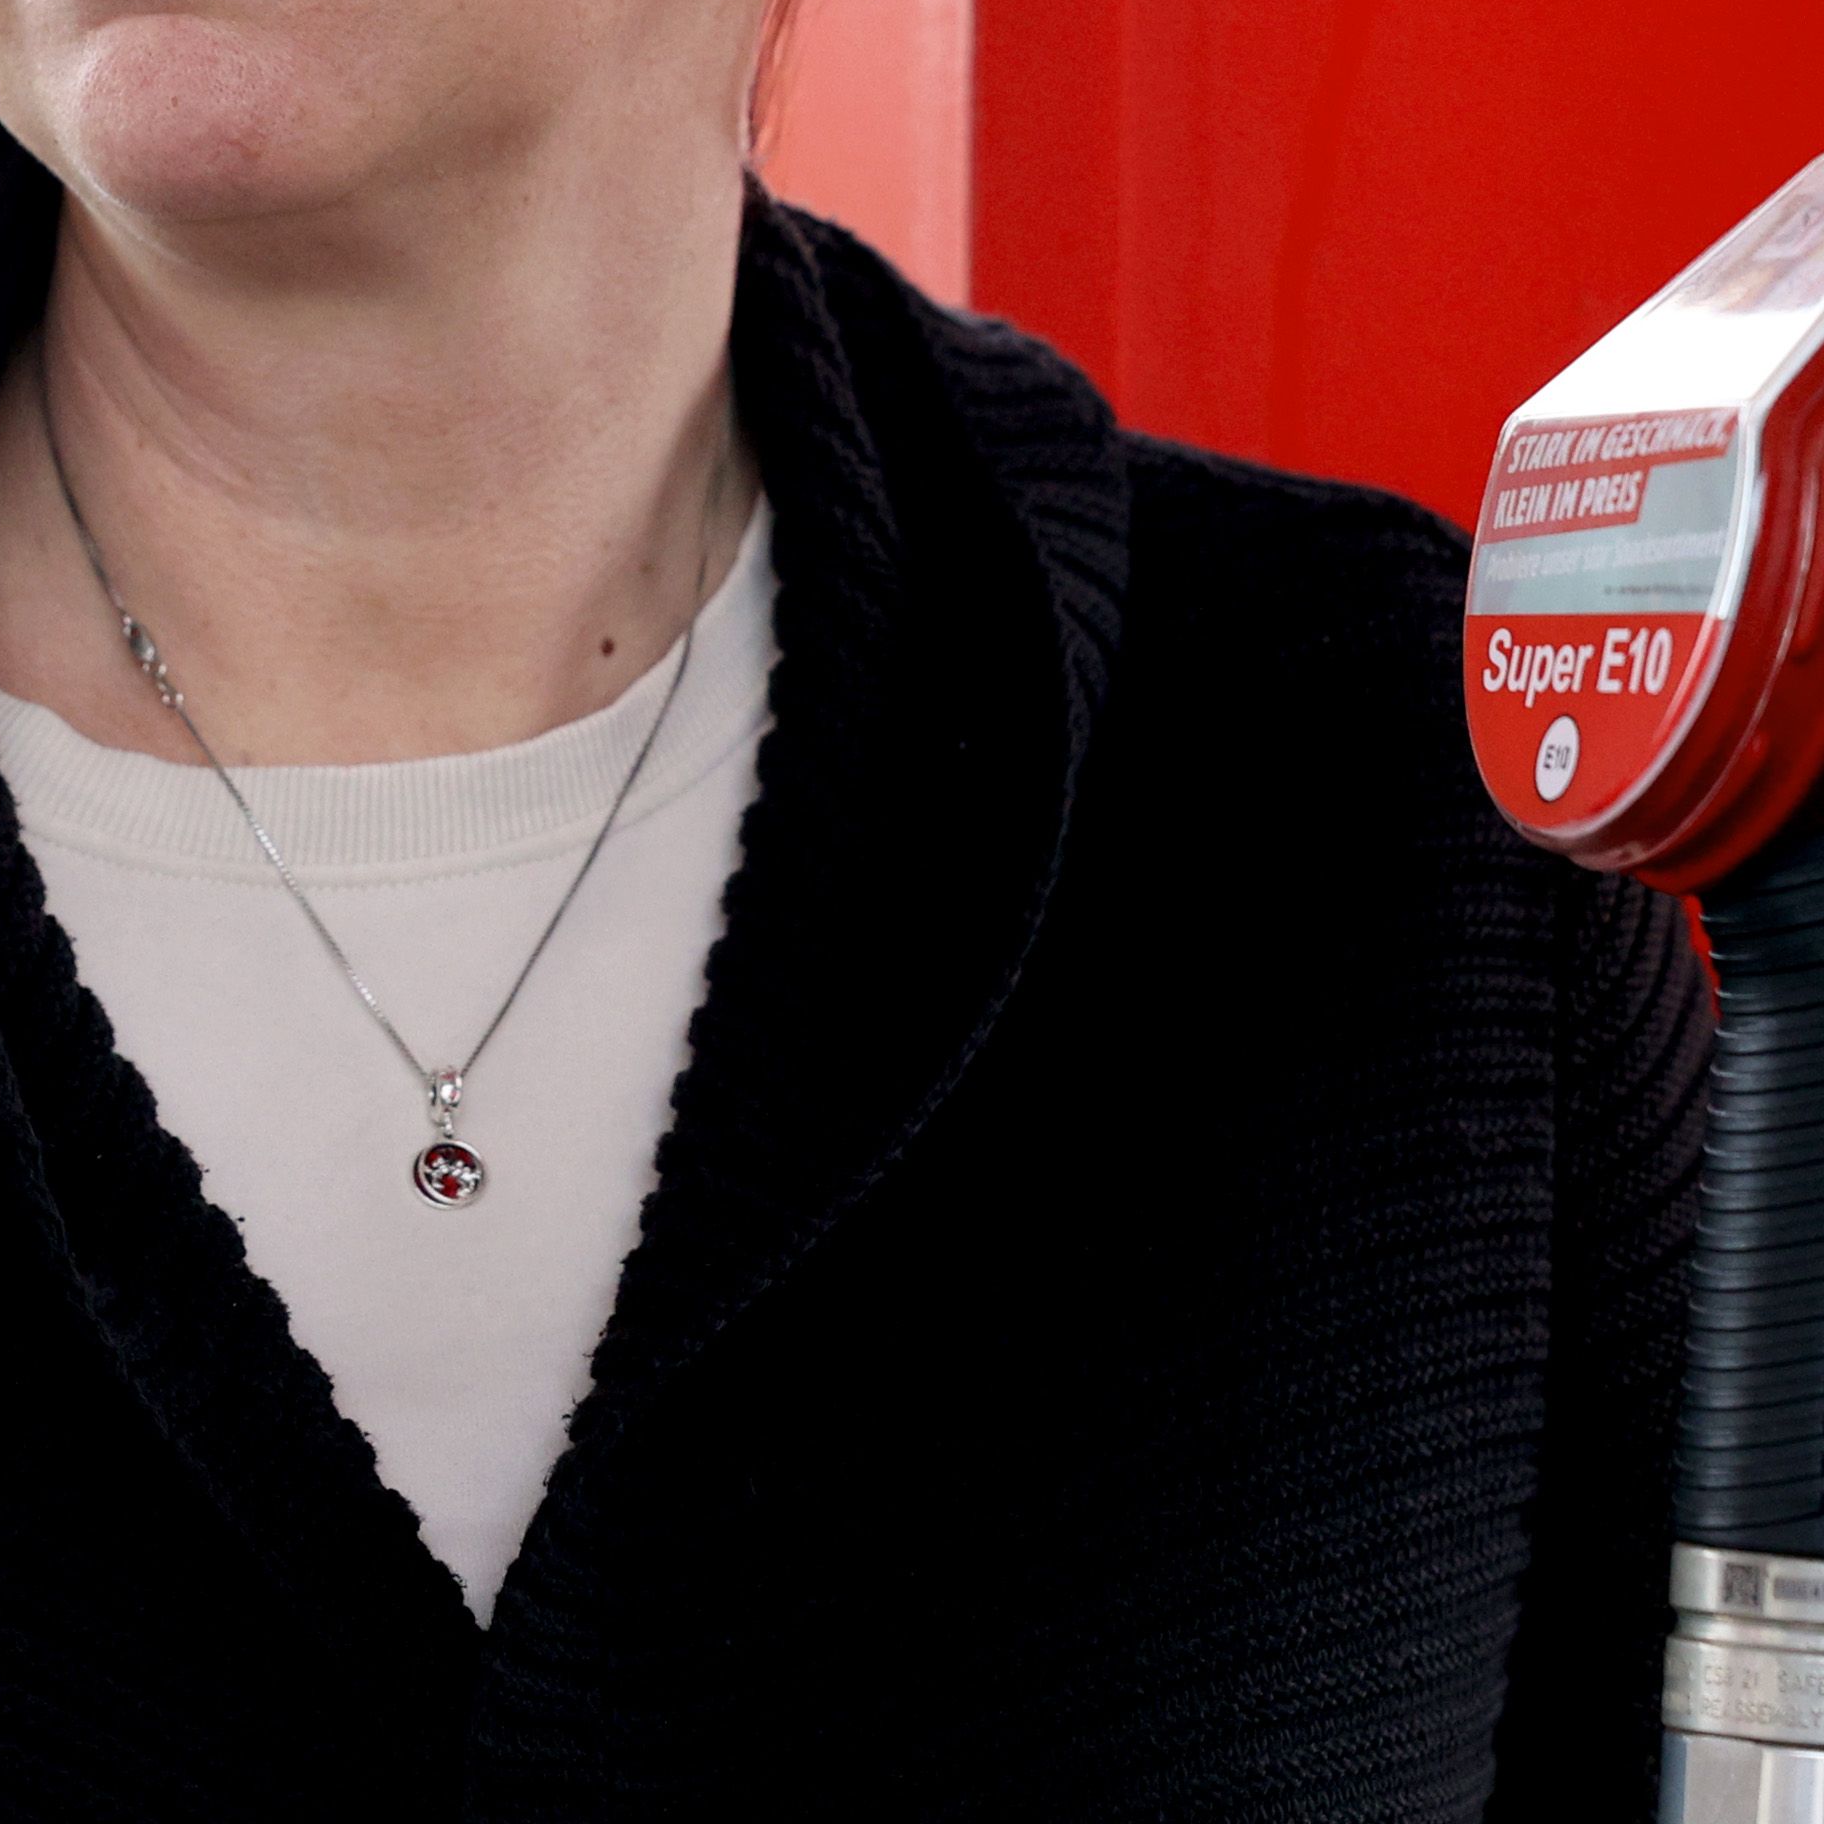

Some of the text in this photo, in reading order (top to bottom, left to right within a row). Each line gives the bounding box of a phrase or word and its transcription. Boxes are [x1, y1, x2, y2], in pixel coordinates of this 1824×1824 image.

[1508, 430, 1575, 474] STARK
[1572, 425, 1609, 465] IM
[1493, 470, 1644, 530] KLEIN IM PREIS
[1482, 626, 1673, 708] Super E10
[1543, 743, 1571, 772] E10
